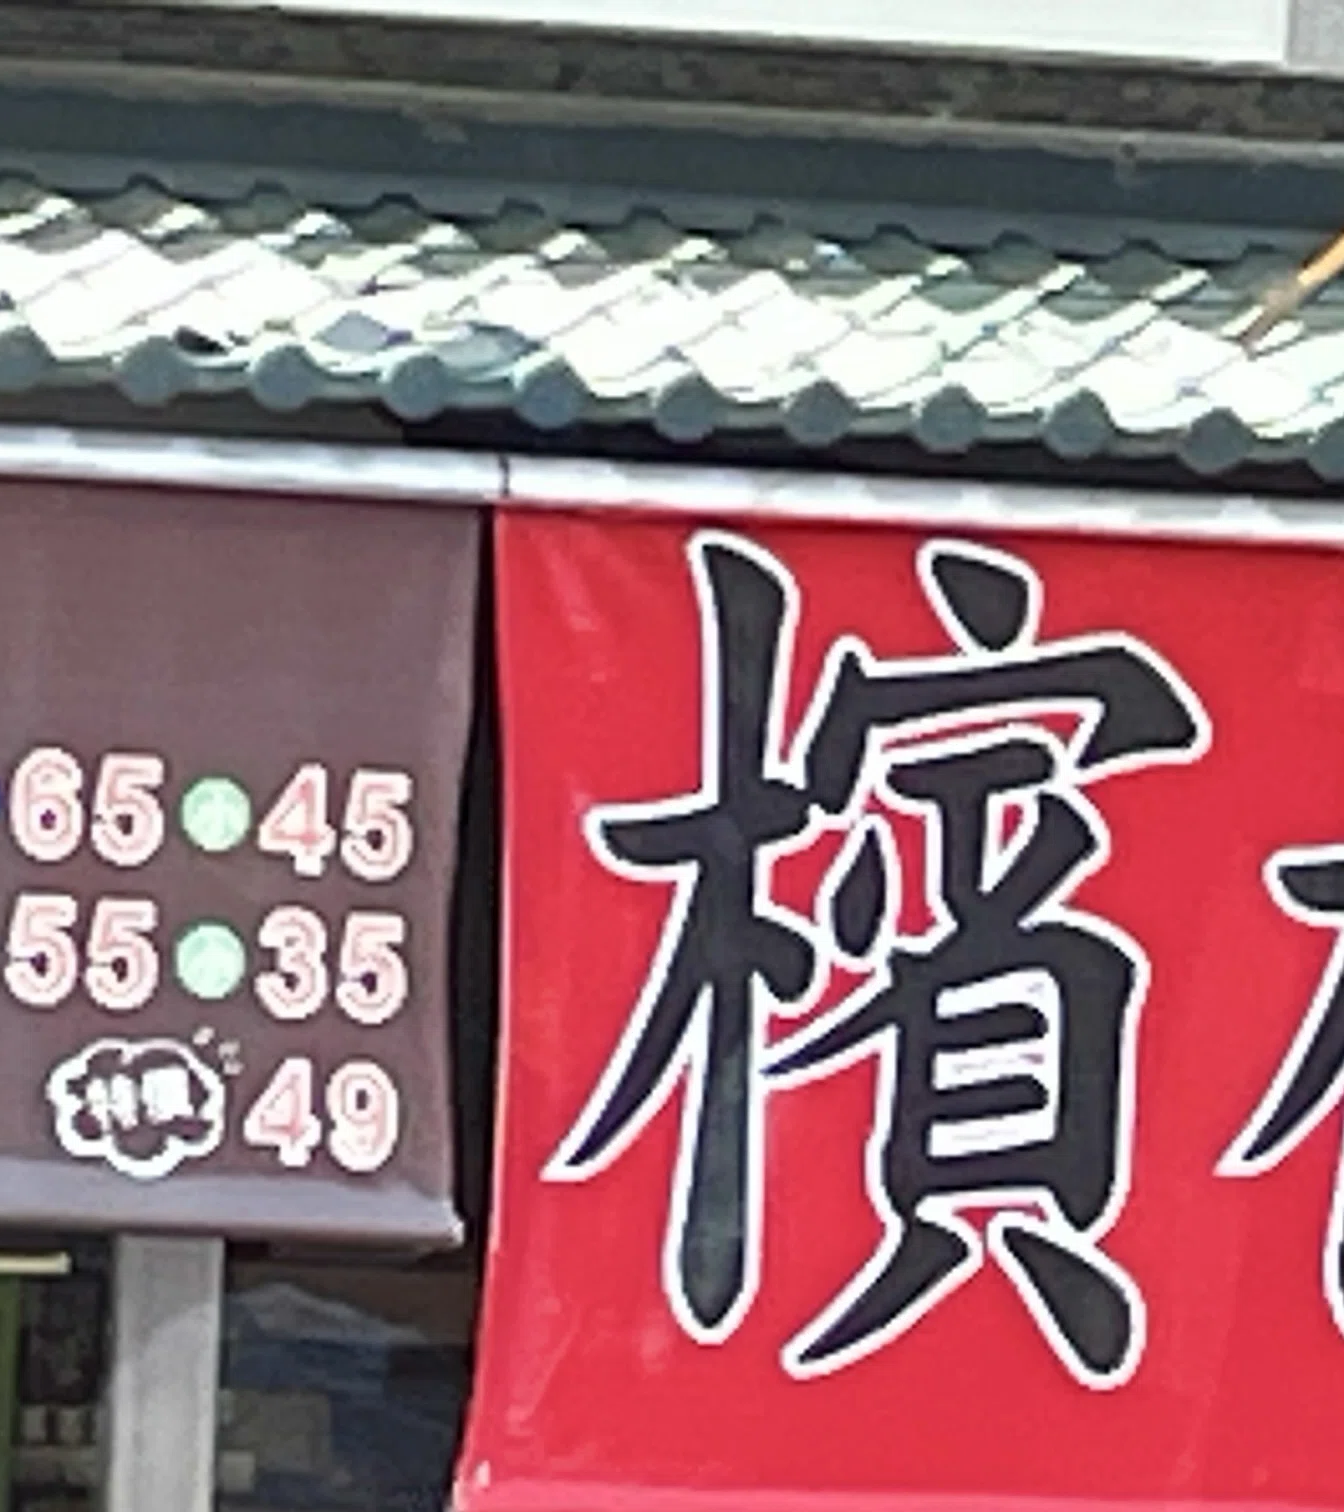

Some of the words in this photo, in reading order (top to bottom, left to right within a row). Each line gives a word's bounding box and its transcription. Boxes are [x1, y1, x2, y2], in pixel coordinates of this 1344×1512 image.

[10, 747, 165, 865] 65
[258, 763, 412, 879] 45
[4, 893, 159, 1010] 55
[256, 905, 408, 1025] 35
[244, 1057, 398, 1172] 49
